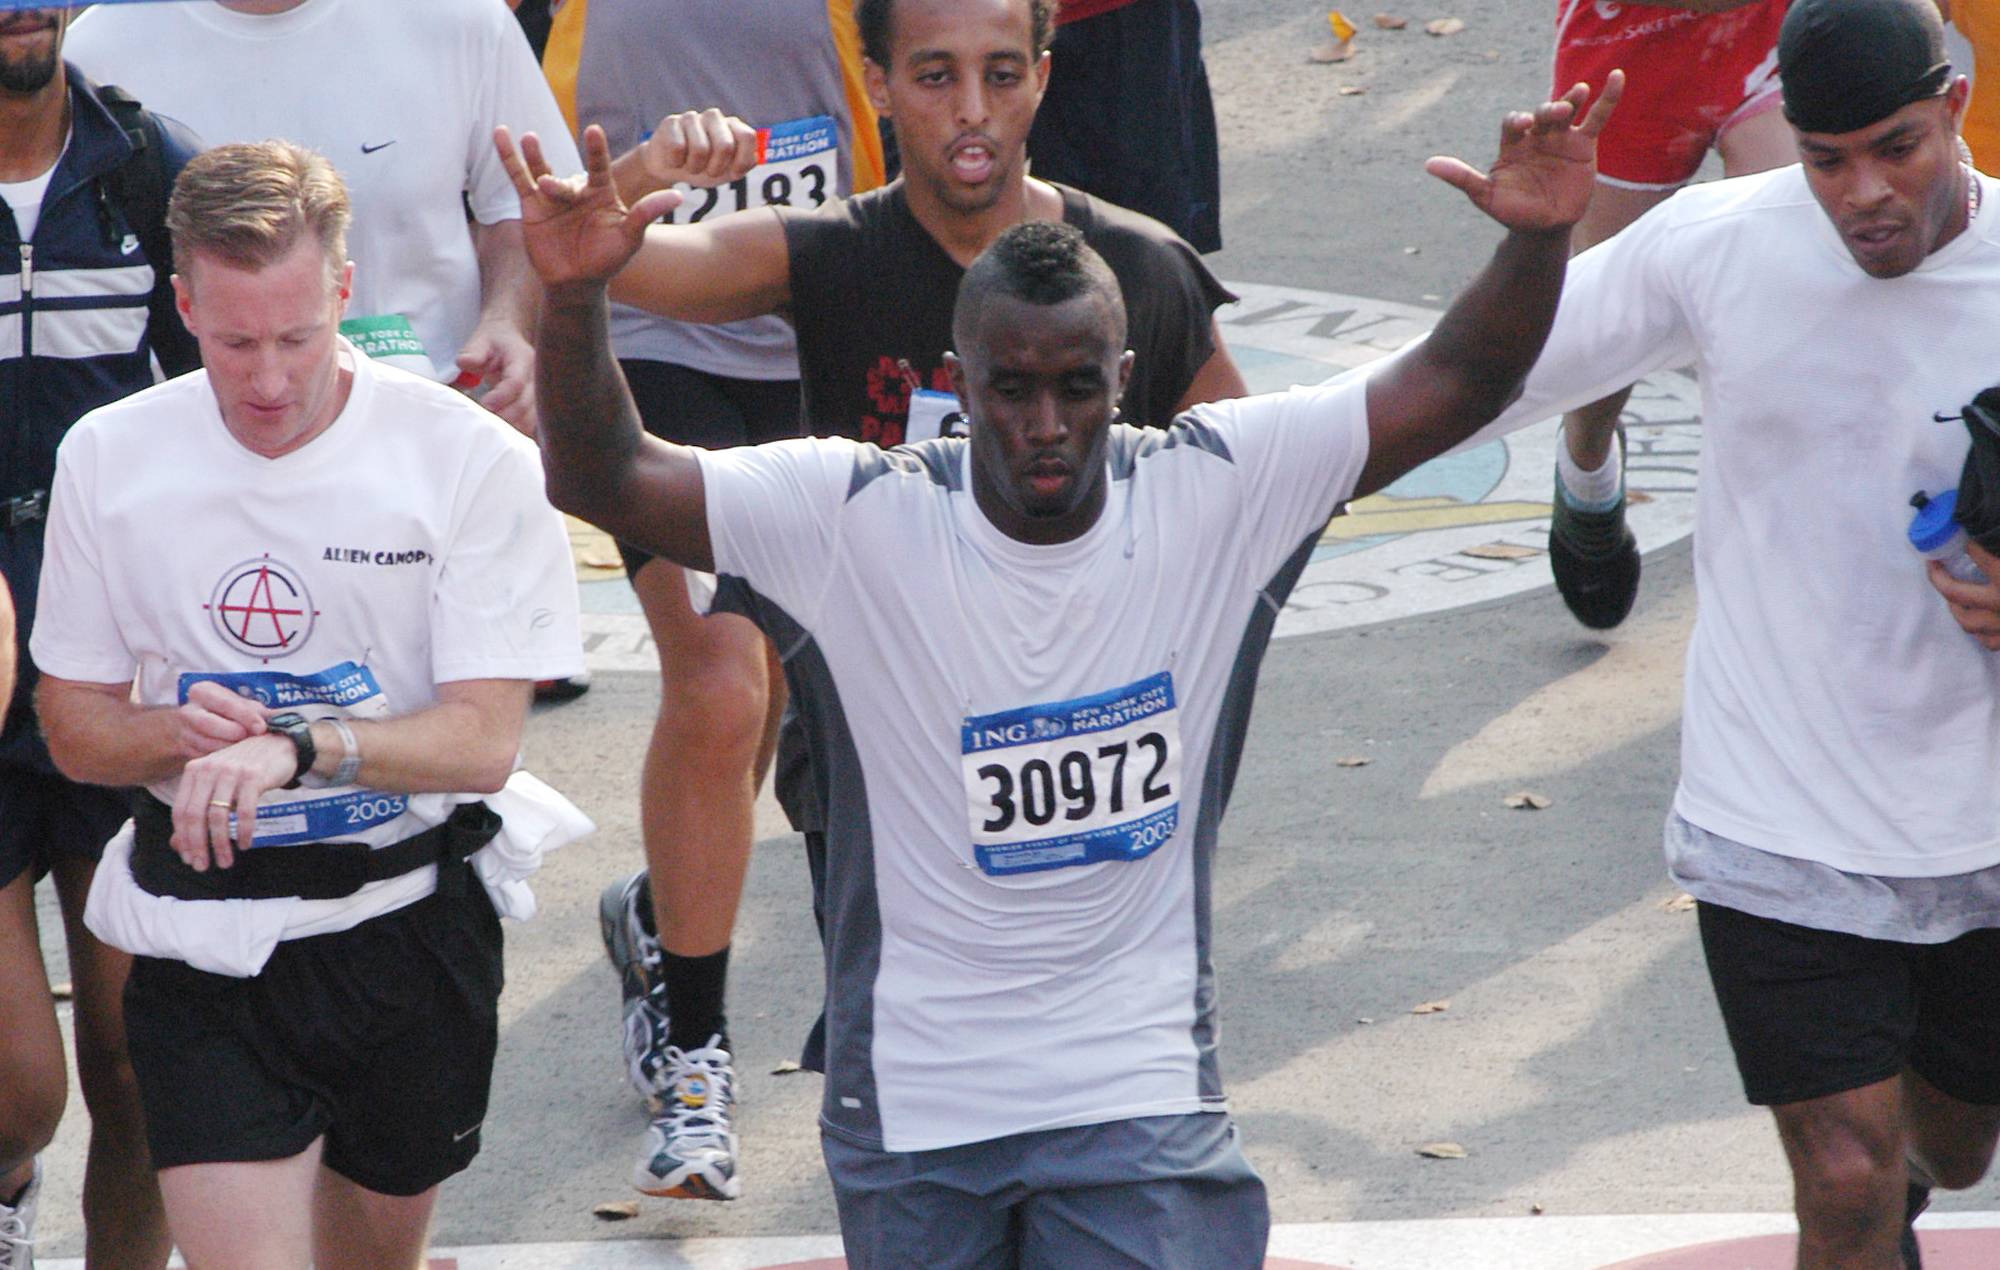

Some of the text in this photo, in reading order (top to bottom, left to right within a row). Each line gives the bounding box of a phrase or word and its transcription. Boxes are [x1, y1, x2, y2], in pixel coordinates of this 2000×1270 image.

[803, 128, 827, 141] CITY
[766, 137, 829, 160] RATHON
[323, 547, 370, 564] ALIEN
[340, 673, 363, 688] CITY
[276, 682, 370, 704] MARATHON
[1072, 707, 1099, 720] NEW
[1104, 697, 1136, 711] YORK
[1072, 696, 1167, 731] MARATHON
[971, 724, 1027, 750] ING
[977, 732, 1171, 832] 30972
[345, 799, 404, 824] 2003
